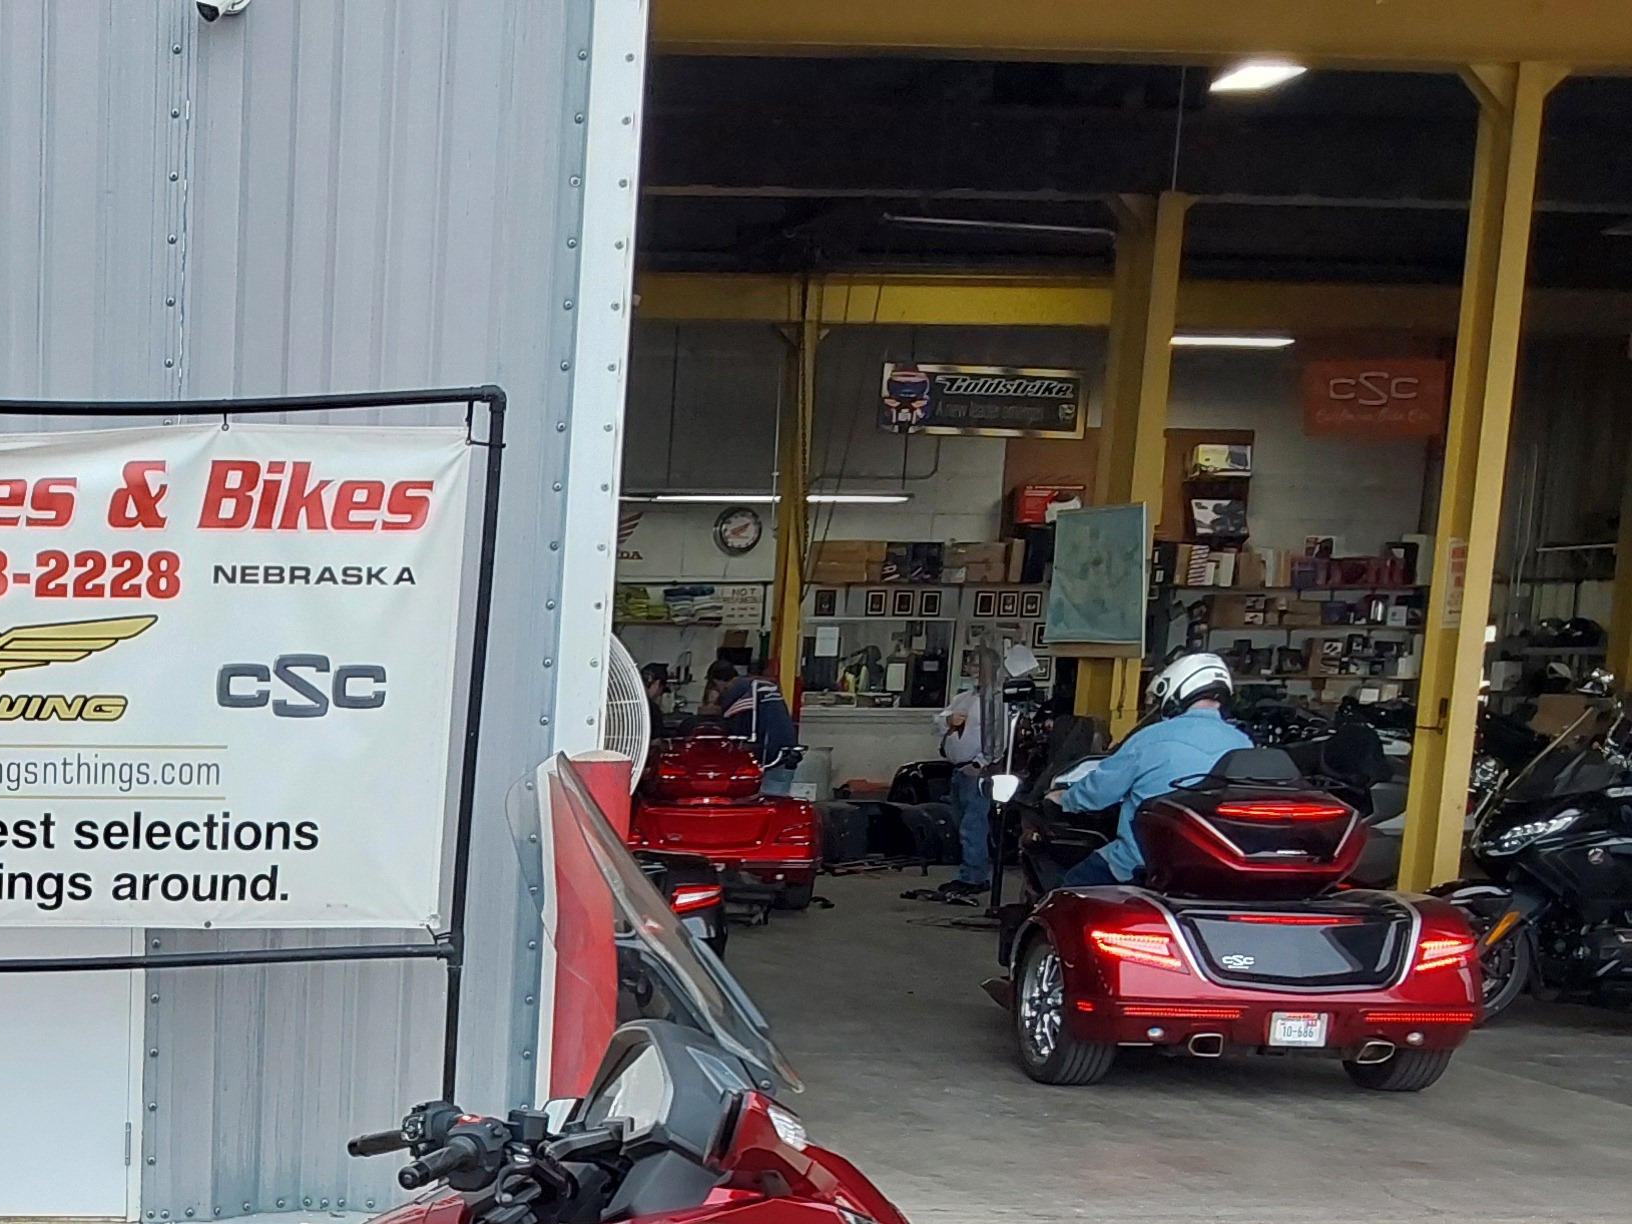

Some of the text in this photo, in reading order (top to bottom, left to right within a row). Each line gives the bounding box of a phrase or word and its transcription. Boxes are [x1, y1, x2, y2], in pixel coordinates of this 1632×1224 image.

[107, 460, 167, 530] &
[197, 459, 435, 532] Bikes
[213, 564, 417, 586] NEBRASKA
[73, 811, 319, 851] selections
[111, 864, 289, 902] around.
[1282, 1026, 1314, 1038] 10-686
